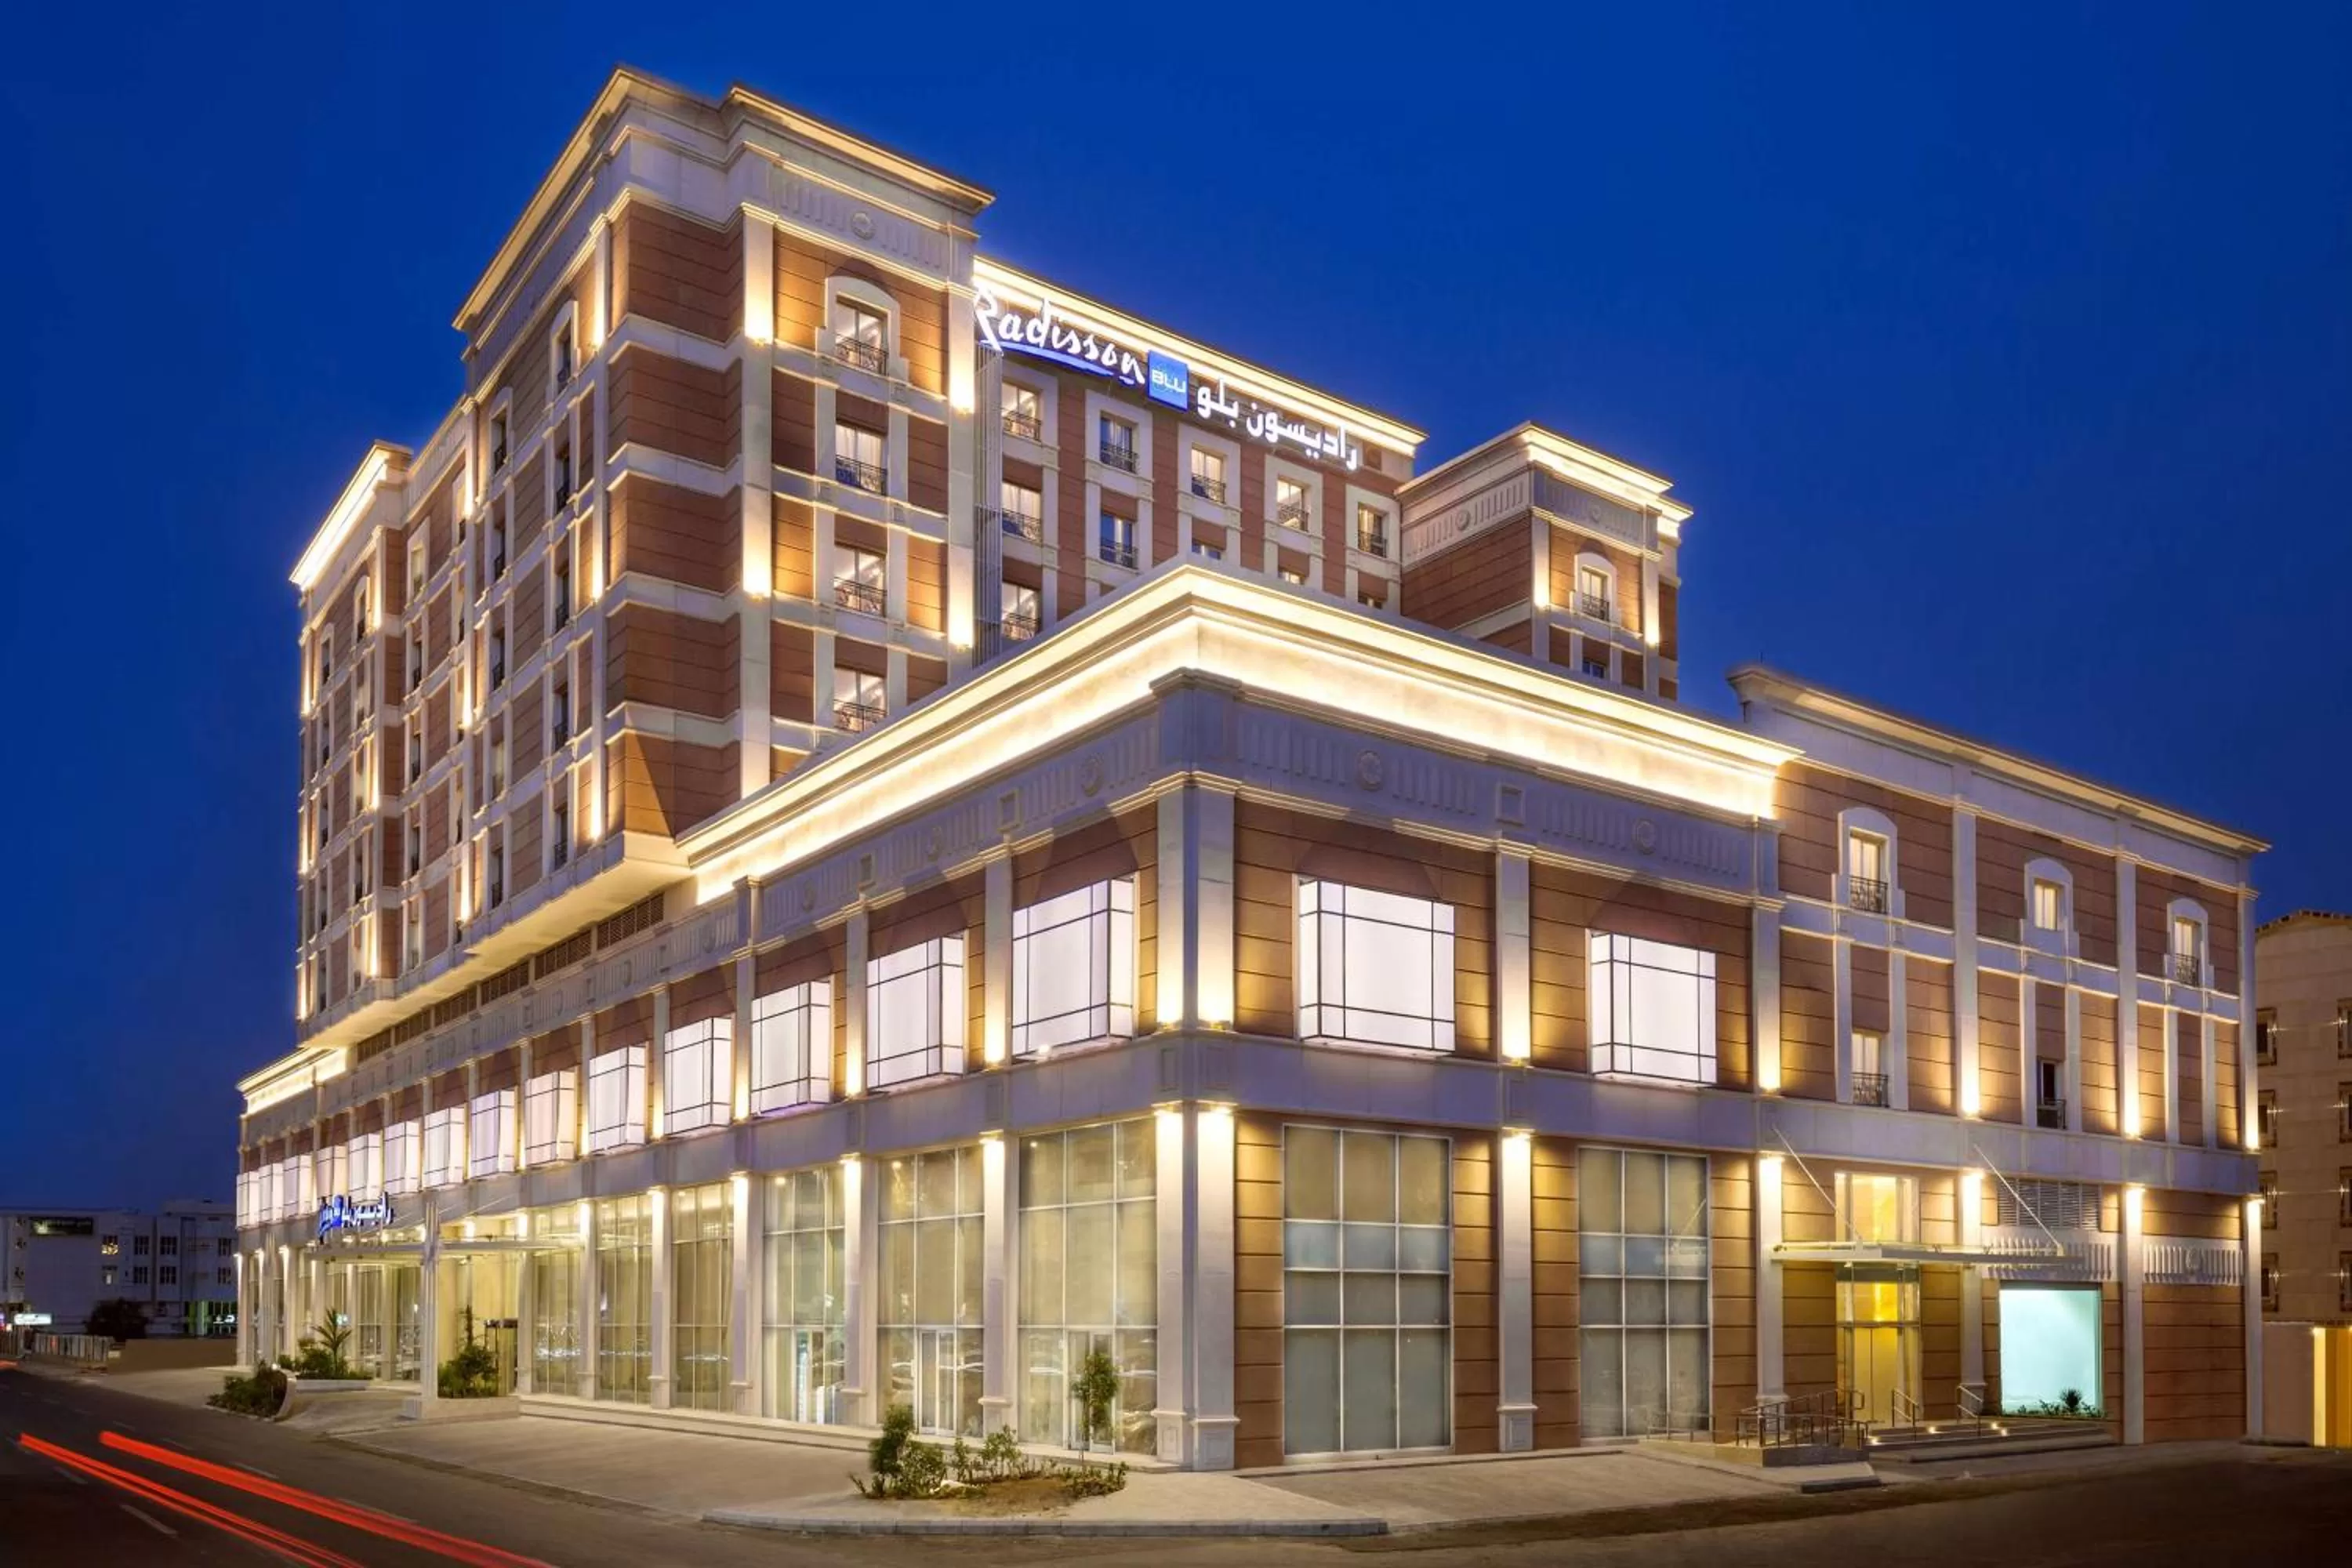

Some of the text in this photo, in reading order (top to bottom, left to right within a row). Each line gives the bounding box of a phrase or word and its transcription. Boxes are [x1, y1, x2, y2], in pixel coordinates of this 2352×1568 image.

[973, 284, 1186, 393] Radisson BLU
[1197, 377, 1357, 470] راديسون بلو
